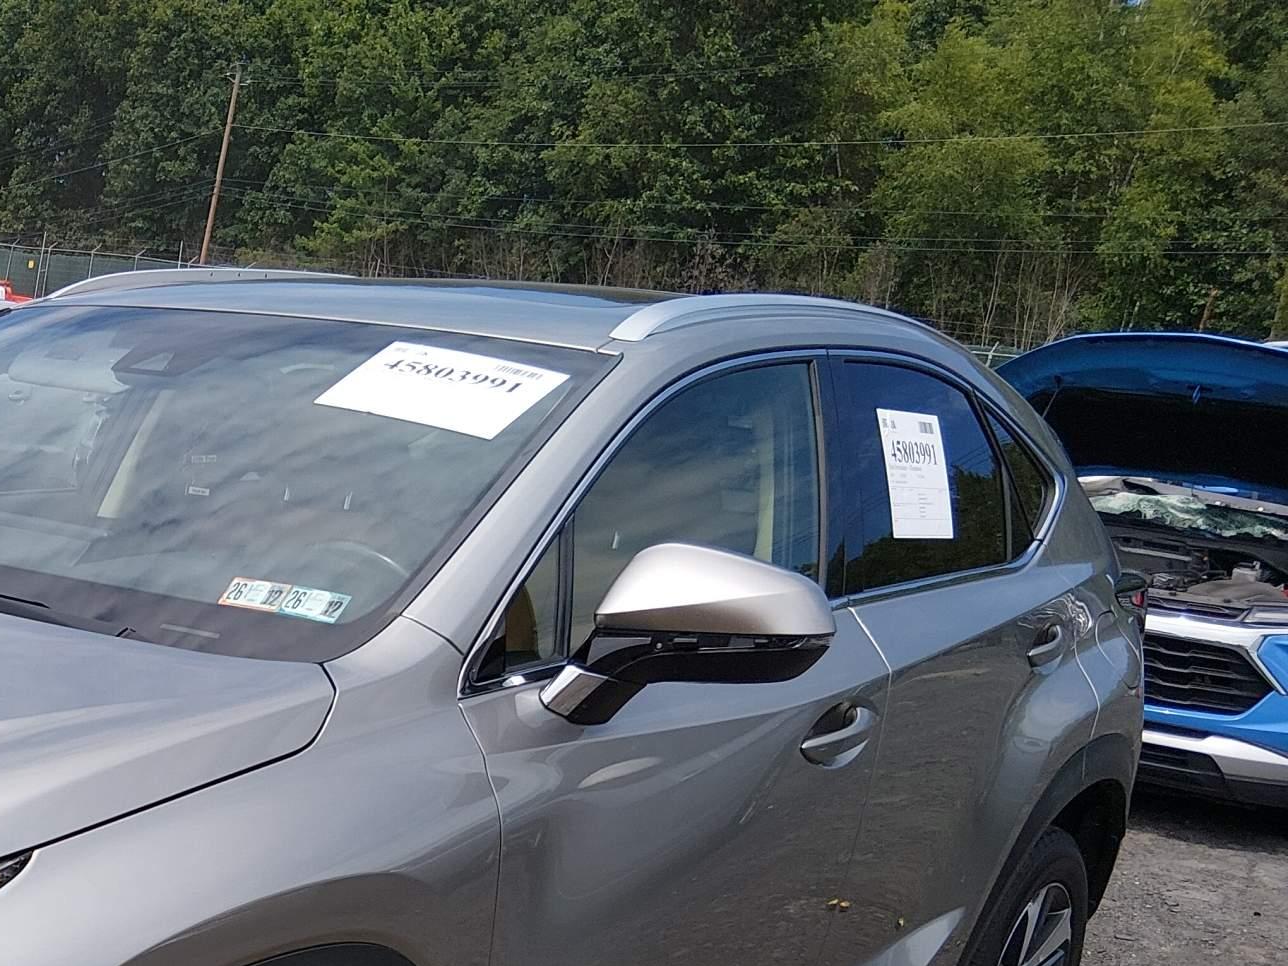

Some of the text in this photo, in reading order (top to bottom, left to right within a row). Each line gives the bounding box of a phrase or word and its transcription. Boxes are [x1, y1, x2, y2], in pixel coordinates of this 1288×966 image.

[383, 359, 523, 393] 45803991
[890, 440, 938, 465] 45803991
[226, 582, 283, 607] 26 12
[284, 590, 343, 618] 26 12
